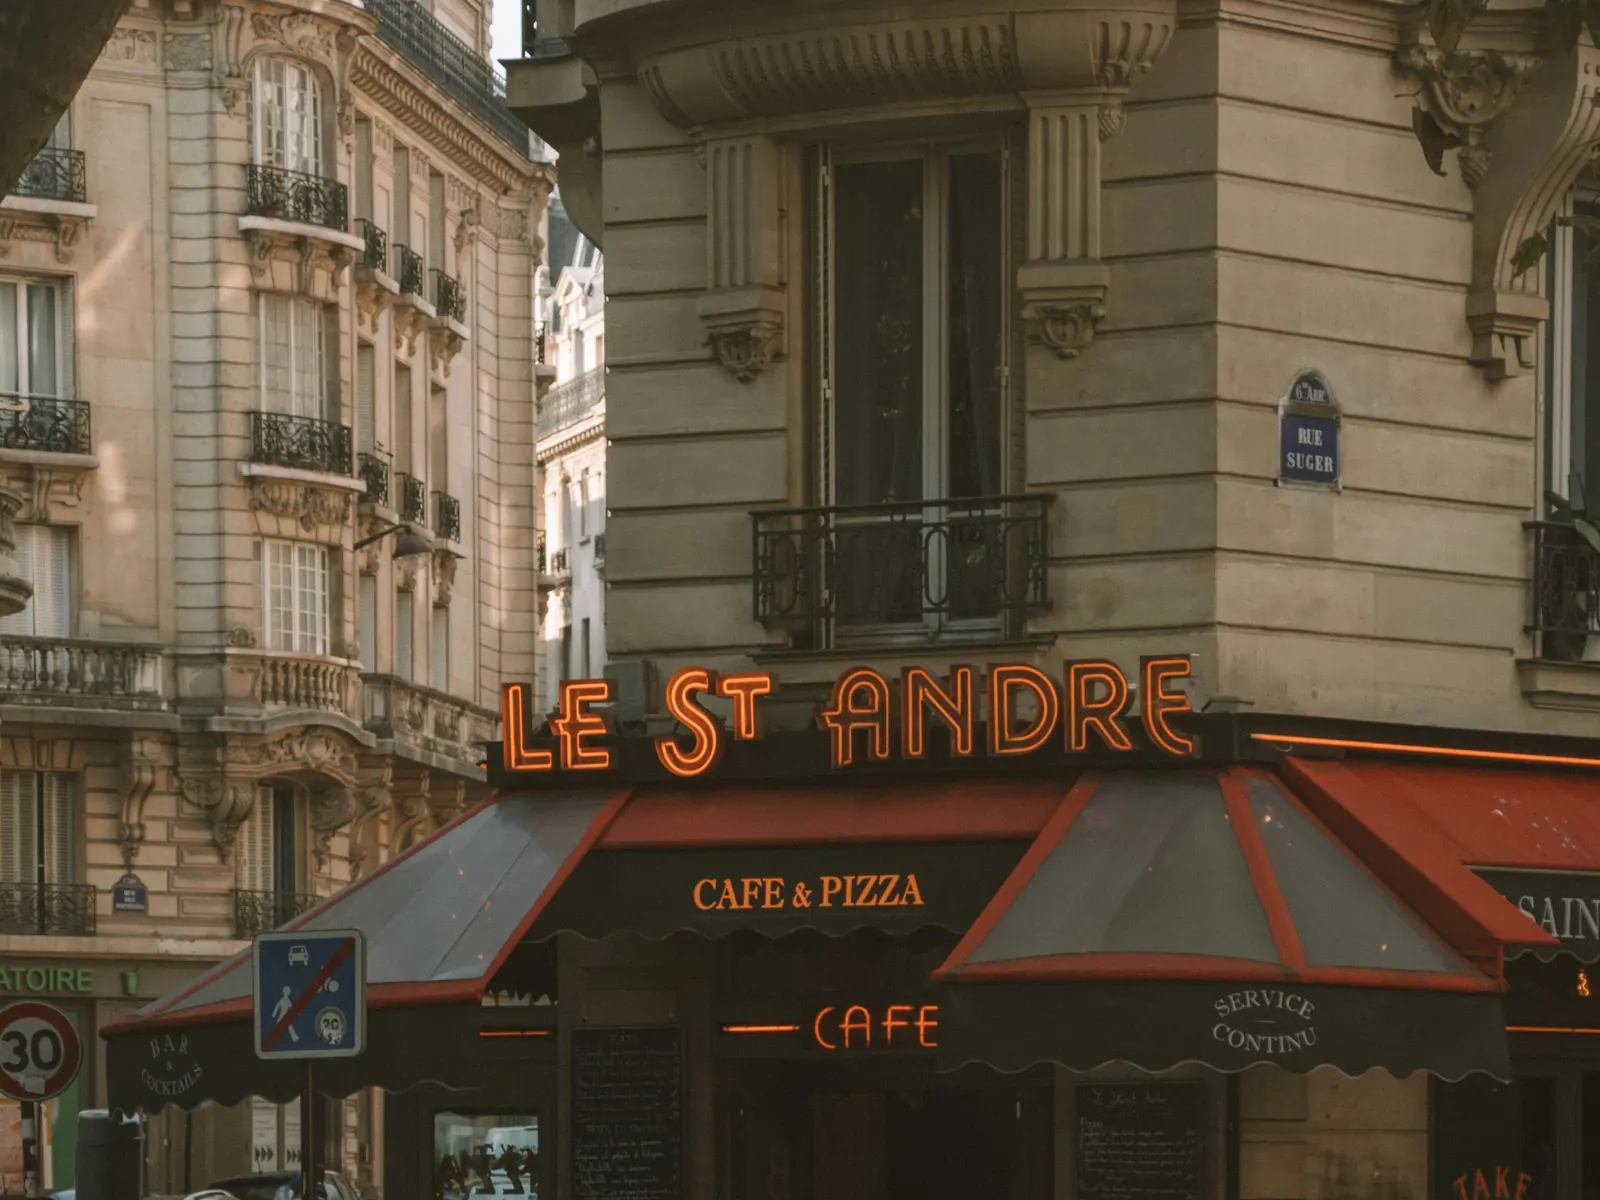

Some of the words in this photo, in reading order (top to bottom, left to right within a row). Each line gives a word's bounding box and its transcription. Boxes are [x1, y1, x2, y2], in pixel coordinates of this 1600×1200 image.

[1298, 427, 1323, 446] RUE
[1287, 452, 1334, 473] SUGER
[501, 680, 616, 772] LE
[815, 654, 1199, 768] ANDRE
[693, 878, 785, 910] CAFE
[792, 881, 813, 908] &
[819, 874, 925, 907] PIZZA
[1214, 989, 1315, 1020] SERVICE
[813, 1004, 940, 1049] CAFE
[1212, 1023, 1317, 1053] CONTINU
[0, 1029, 62, 1073] 30
[150, 1034, 188, 1058] BAR
[141, 1063, 203, 1096] COCKTAILS
